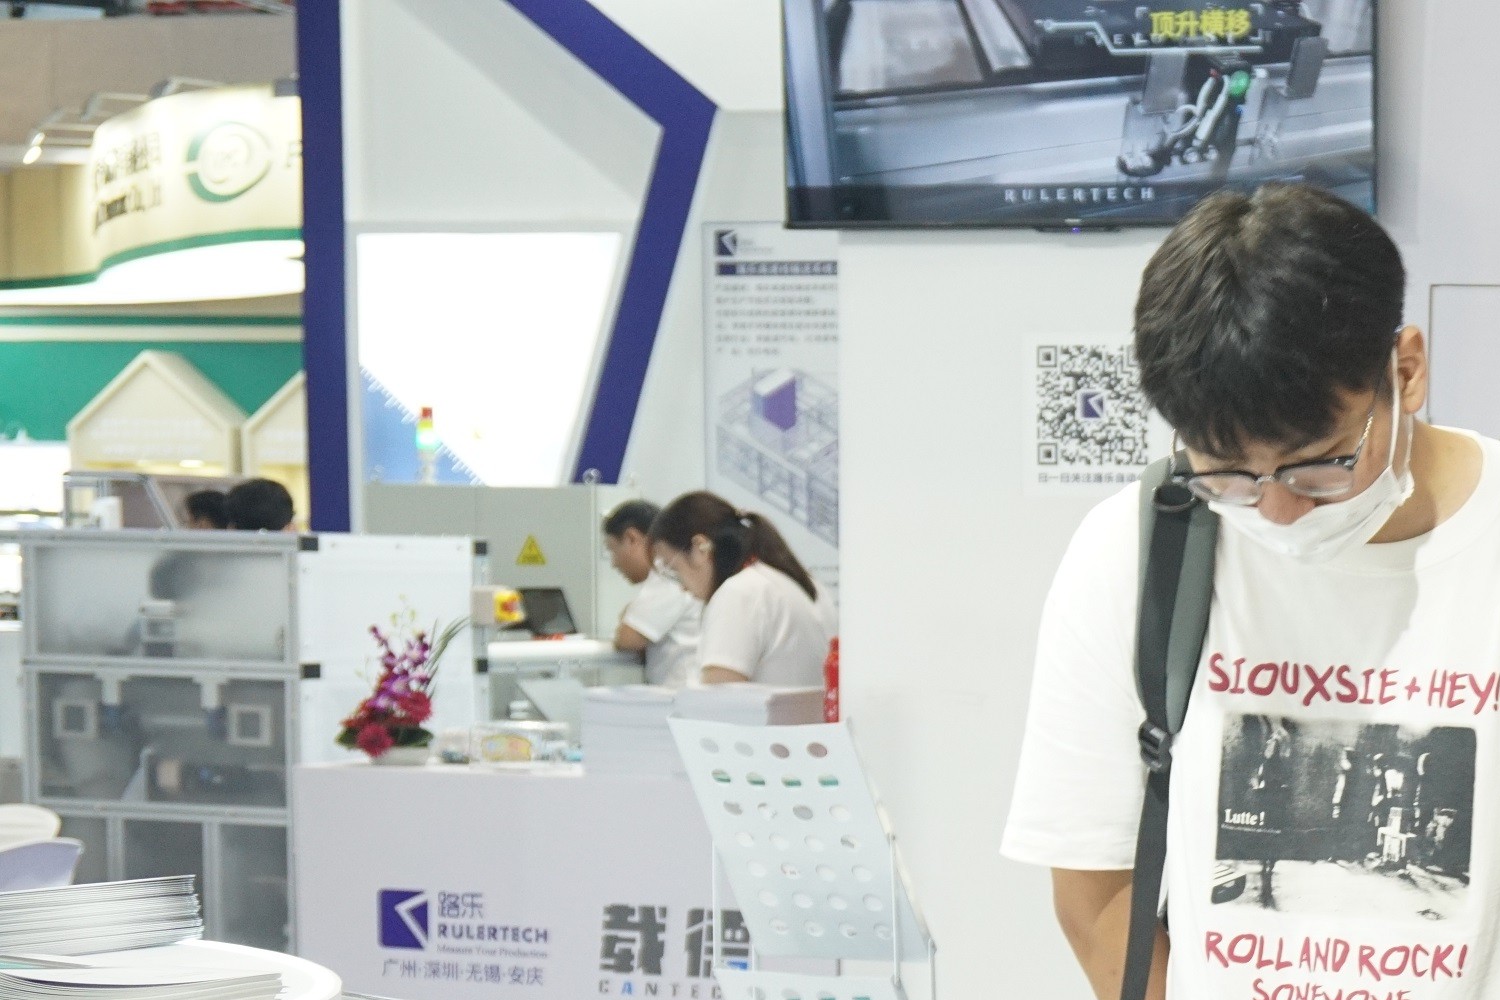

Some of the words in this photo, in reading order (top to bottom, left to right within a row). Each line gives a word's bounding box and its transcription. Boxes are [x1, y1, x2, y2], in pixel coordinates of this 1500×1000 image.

[1151, 8, 1250, 38] 顶升横移
[1004, 187, 1155, 203] RULERTECH
[1208, 653, 1400, 707] SIOUXSIE
[437, 891, 484, 919] 路乐
[437, 923, 548, 943] RULERTECH
[1358, 944, 1469, 982] ROCK!
